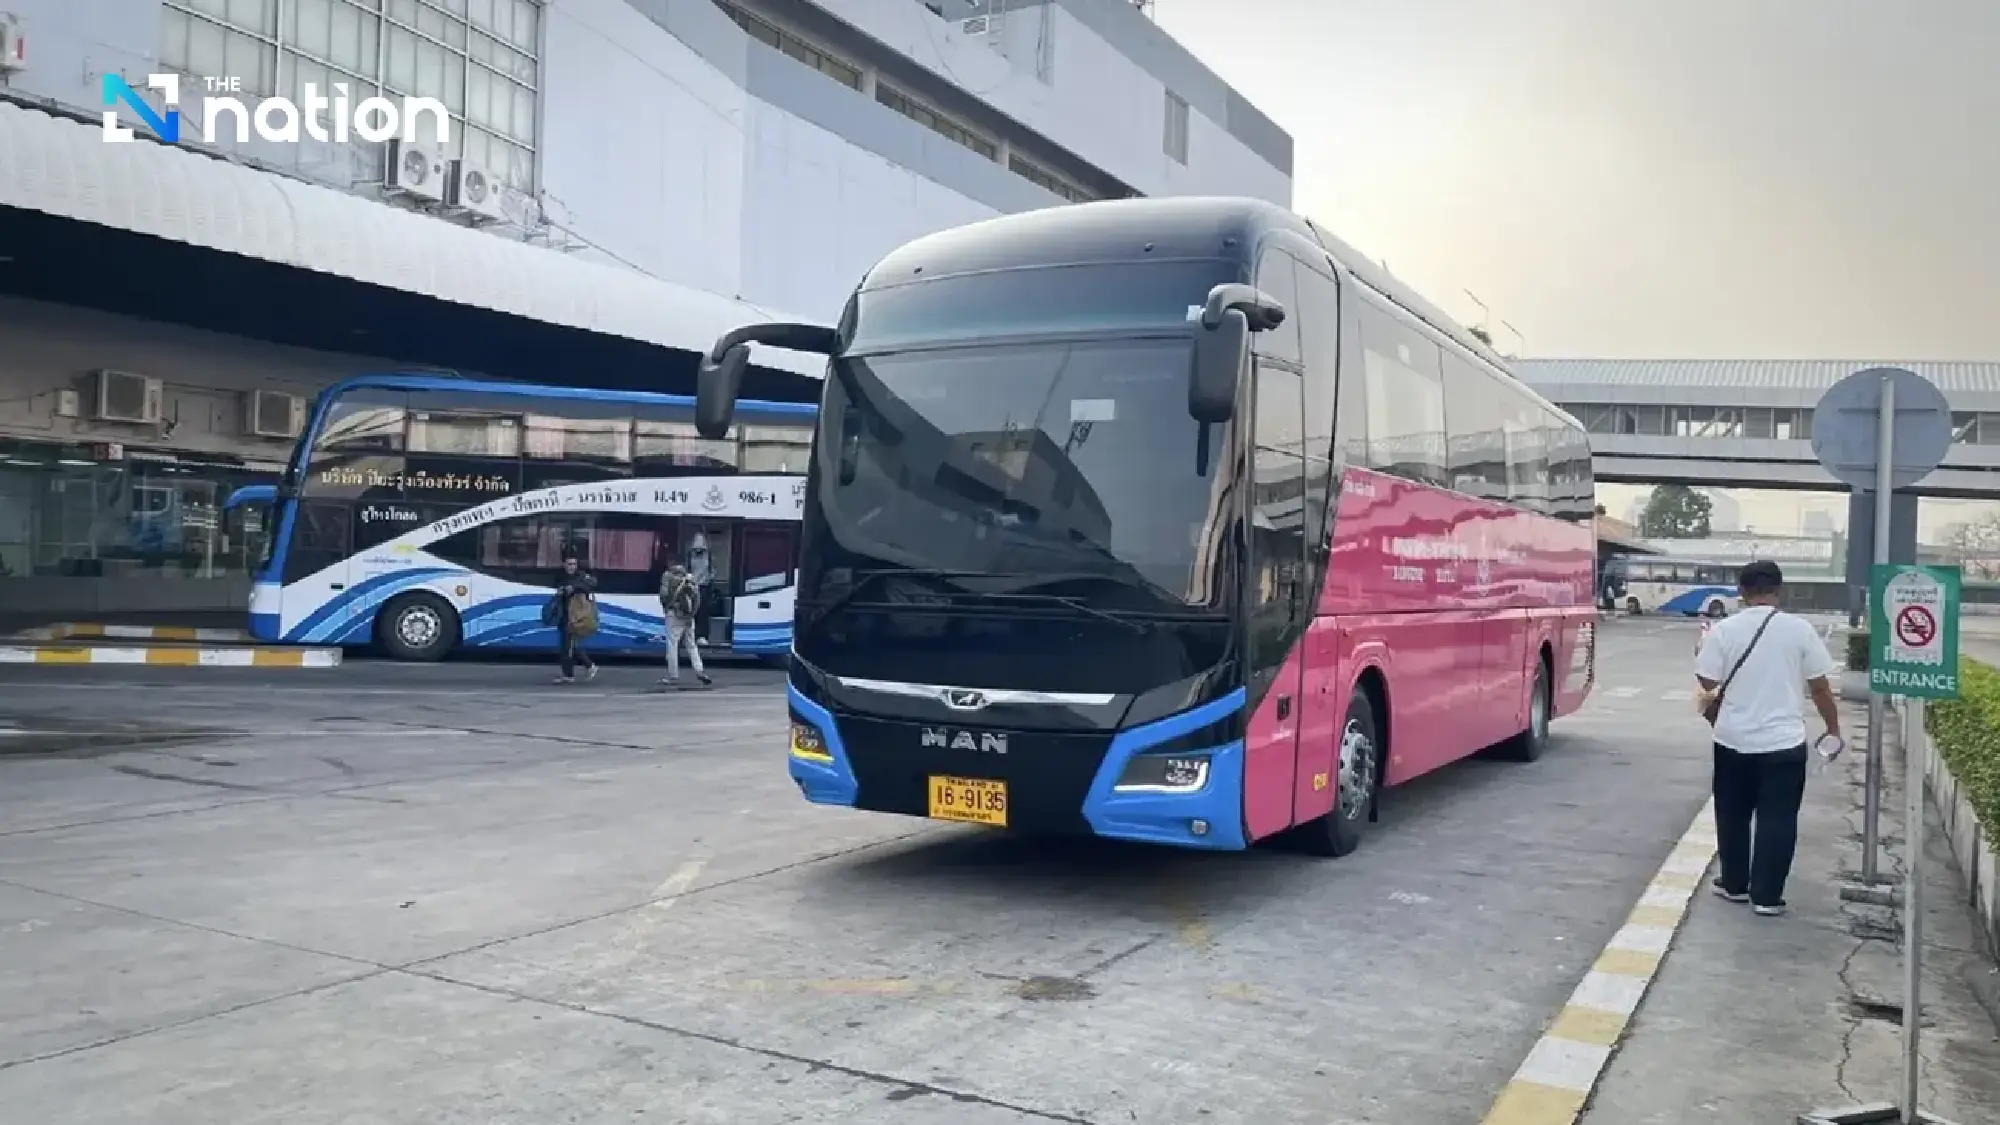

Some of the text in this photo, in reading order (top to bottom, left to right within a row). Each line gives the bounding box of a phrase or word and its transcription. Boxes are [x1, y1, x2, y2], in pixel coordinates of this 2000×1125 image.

[474, 475, 510, 492] จำกัด
[739, 490, 776, 506] 986-1
[1872, 668, 1956, 692] ENTRANCE
[921, 727, 1008, 754] MAN
[937, 785, 1004, 812] 16-9135
